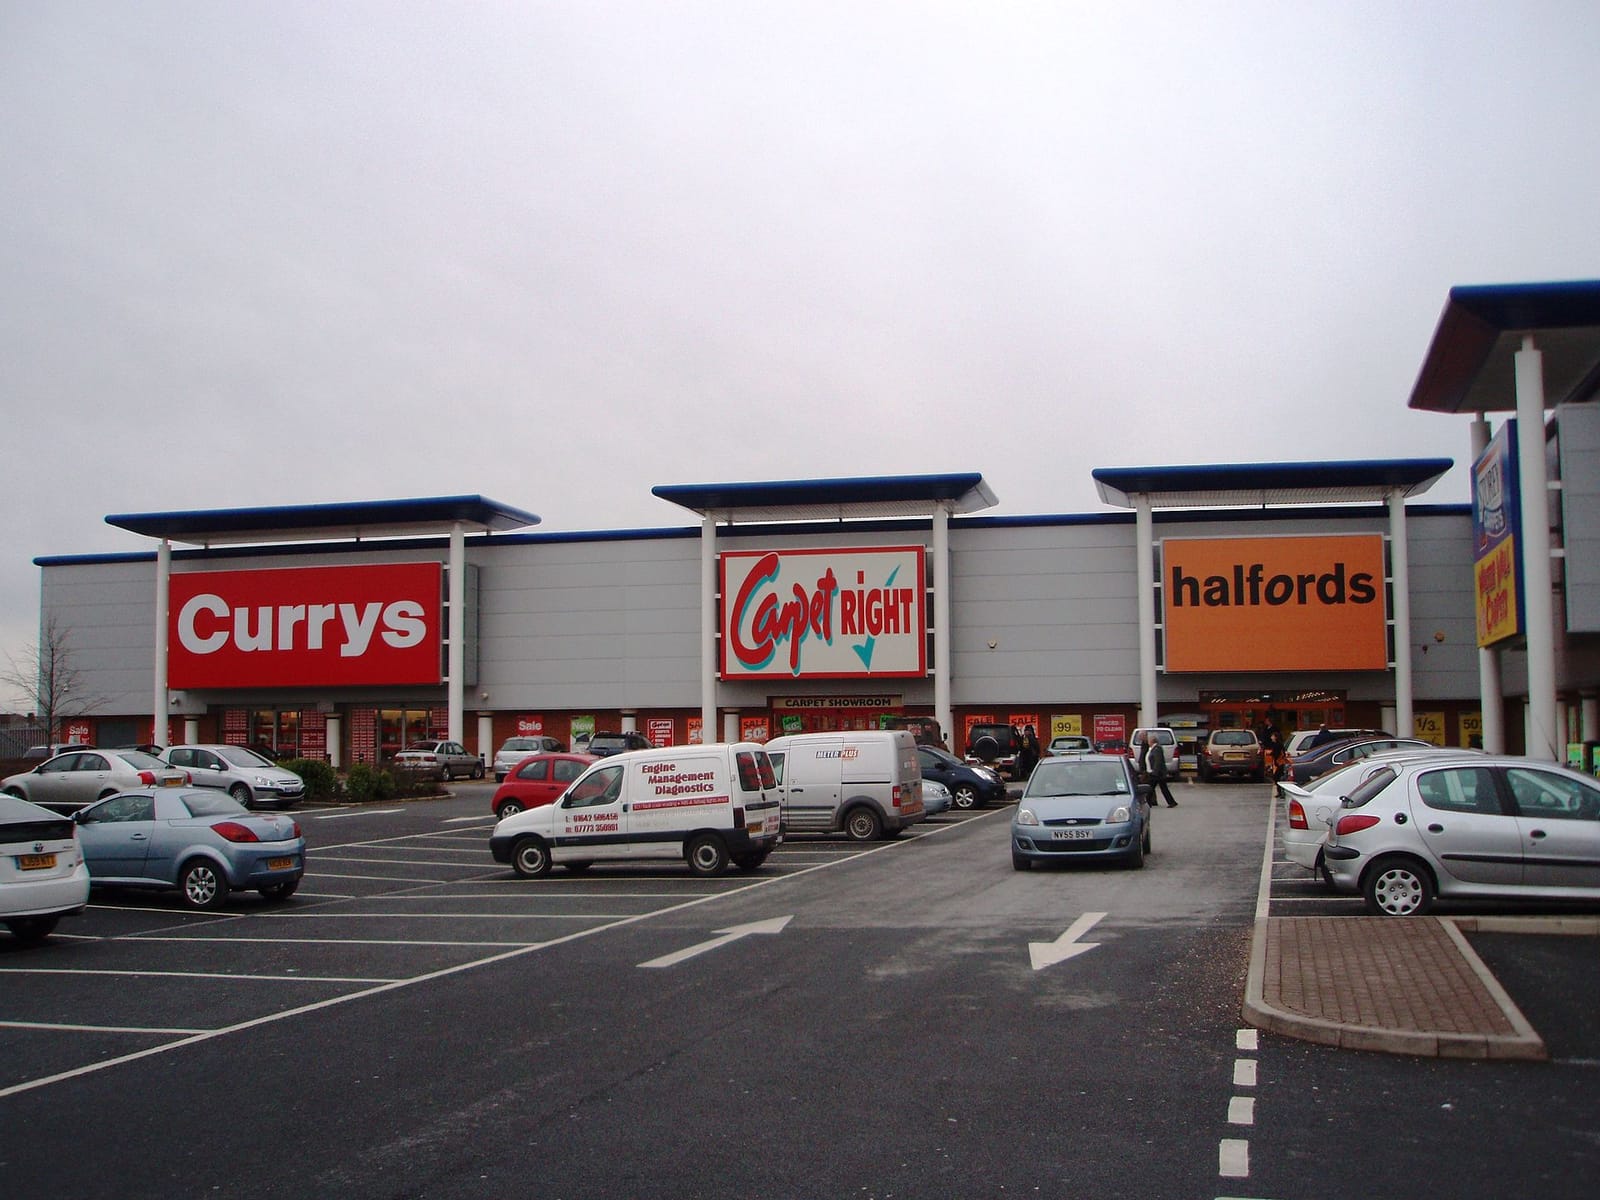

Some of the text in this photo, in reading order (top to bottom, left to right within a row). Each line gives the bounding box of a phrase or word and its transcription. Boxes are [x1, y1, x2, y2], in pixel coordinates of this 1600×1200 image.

[1172, 563, 1376, 607] halfords
[730, 553, 913, 675] Carpet RIGHT
[177, 593, 427, 657] Currys
[785, 698, 891, 707] CARPET SHOWROOM
[69, 725, 89, 735] Sale
[519, 721, 542, 731] Sale
[572, 721, 593, 731] New
[743, 719, 767, 730] SALE
[642, 763, 676, 774] Engine
[648, 771, 714, 785] Management
[655, 783, 714, 795] Diagnostics
